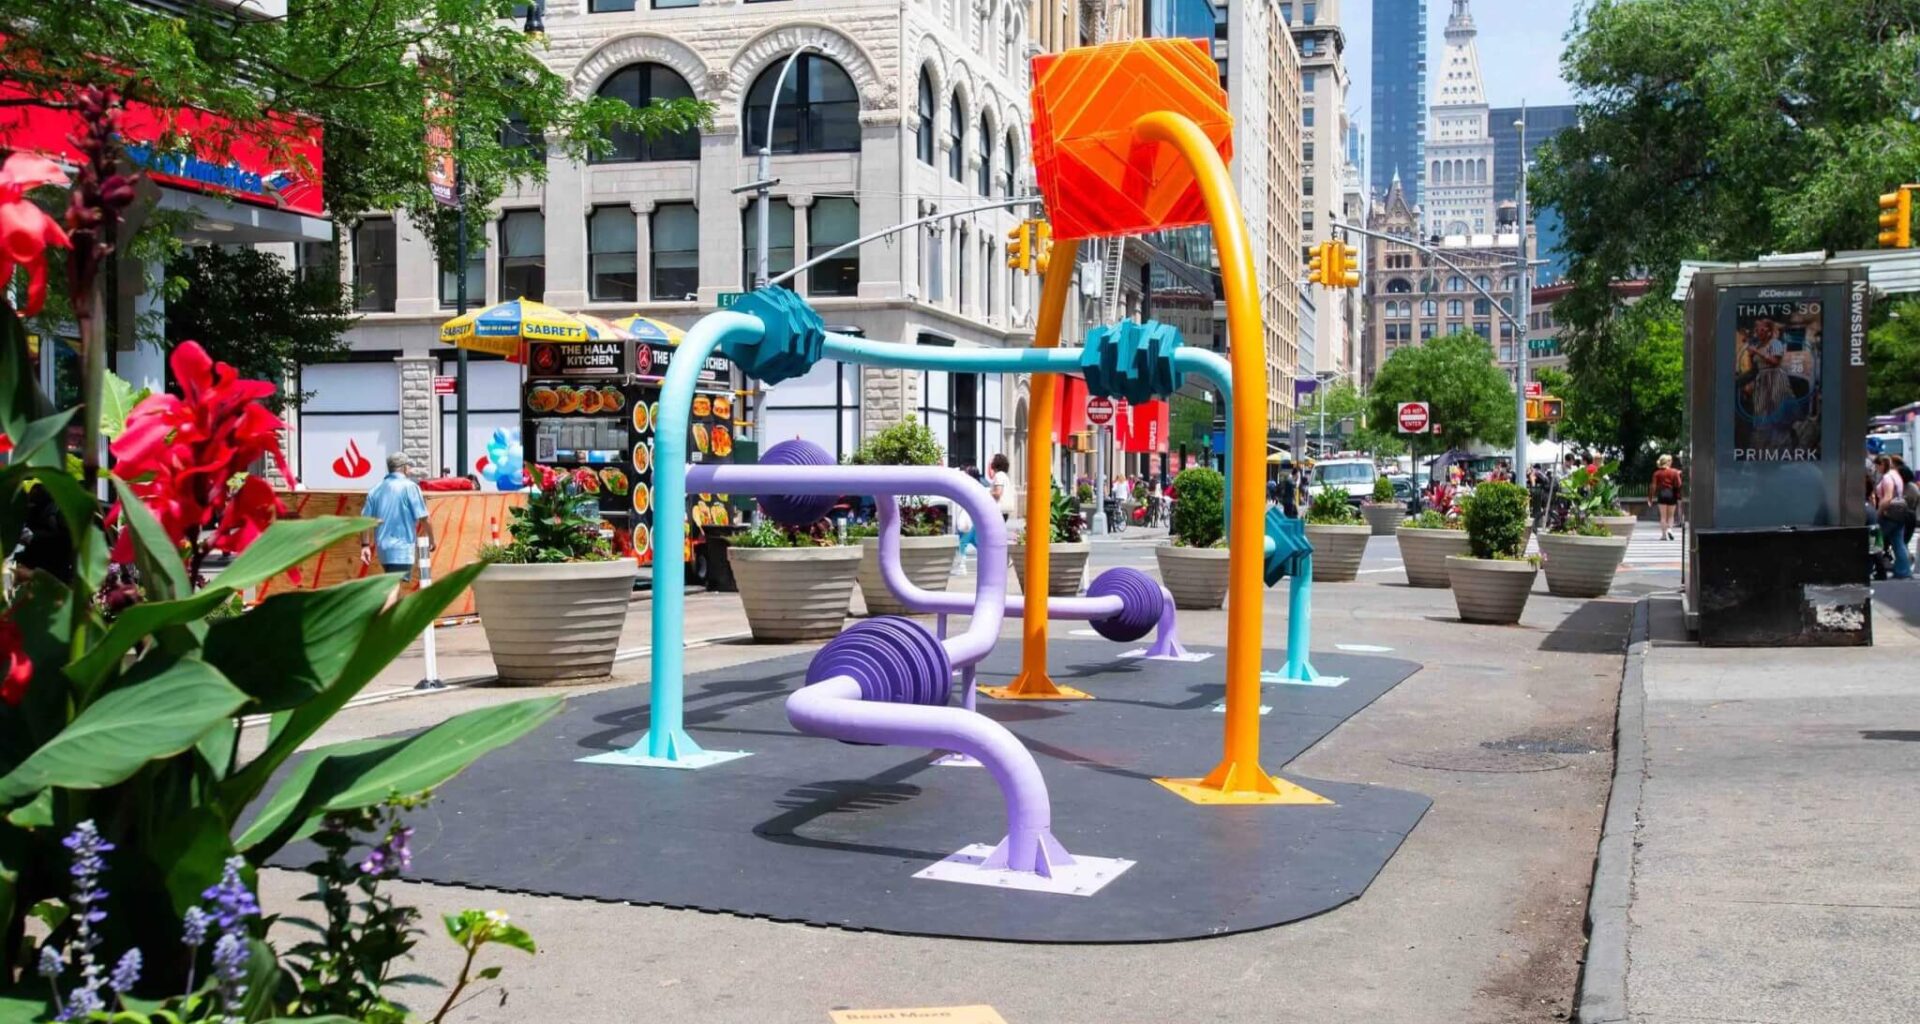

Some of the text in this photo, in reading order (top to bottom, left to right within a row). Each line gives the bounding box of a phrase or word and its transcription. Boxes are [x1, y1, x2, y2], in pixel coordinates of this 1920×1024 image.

[723, 294, 728, 306] E
[1737, 304, 1791, 316] THAT'S
[1850, 280, 1867, 367] Newsstand
[525, 323, 582, 337] SABRETT
[560, 344, 621, 355] THE HALAL
[566, 355, 614, 366] KITCHEN
[652, 350, 669, 365] THE
[703, 357, 729, 372] TCHEN
[1733, 448, 1818, 461] PRIMARK
